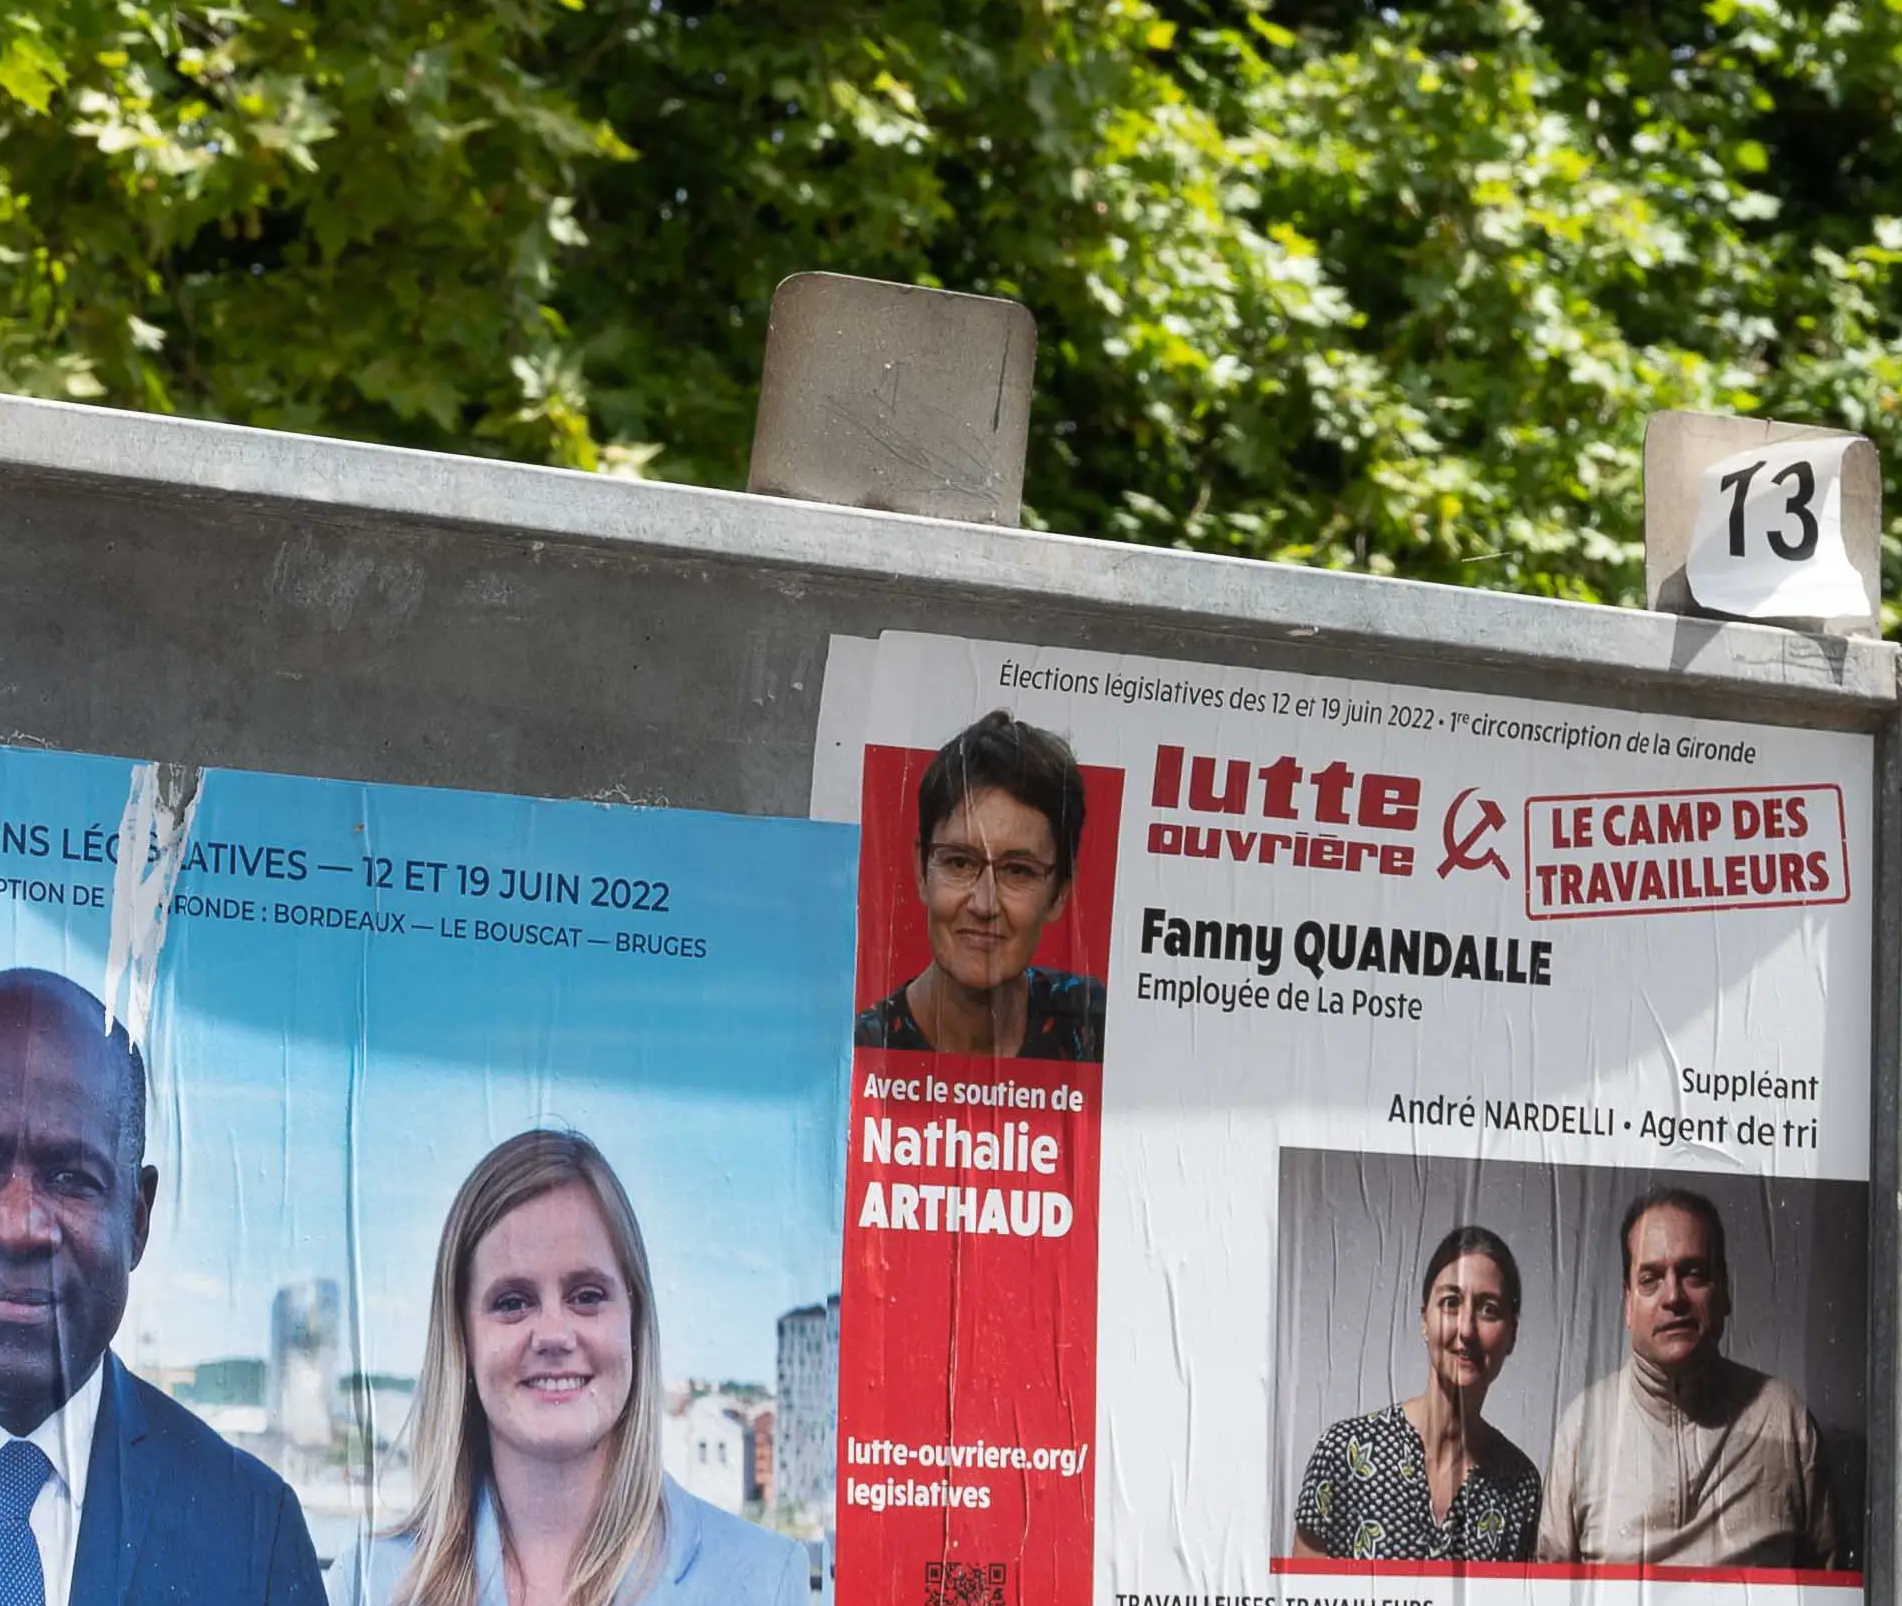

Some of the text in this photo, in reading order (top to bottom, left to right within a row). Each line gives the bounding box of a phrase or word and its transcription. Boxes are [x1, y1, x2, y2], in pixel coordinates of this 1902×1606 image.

[1721, 461, 1818, 561] 13
[1000, 660, 1755, 763] Élections législatives des 12 et 19 juin 2022 1re circonscription de la Gironde
[1152, 742, 1422, 833] lutte
[1147, 818, 1416, 878] ouvrière
[1553, 797, 1807, 849] LE CAMP DES
[363, 857, 392, 888] 12
[406, 861, 447, 892] ET
[457, 865, 489, 896] 19
[499, 869, 579, 904] JUIN
[591, 877, 669, 912] 2022
[1536, 848, 1831, 907] TRAVAILLEURS
[74, 886, 104, 907] DE
[275, 904, 405, 933] BORDEAUX
[441, 918, 467, 938] LE
[475, 921, 582, 947] BOUSCAT
[616, 933, 706, 958] BRUGES
[1142, 908, 1552, 985] Fanny QUANDALLE
[1138, 968, 1422, 1020] Employée de La Poste
[864, 1073, 1083, 1112] Avec le soutien de
[1683, 1068, 1818, 1102] Suppléant
[863, 1117, 1057, 1173] Nathalie
[1389, 1094, 1816, 1148] André NARDELLI Agent de tri
[859, 1182, 1072, 1237] ARTHAUD
[848, 1431, 1087, 1484] lutte-ouvriere.org/
[848, 1478, 990, 1511] legislatives
